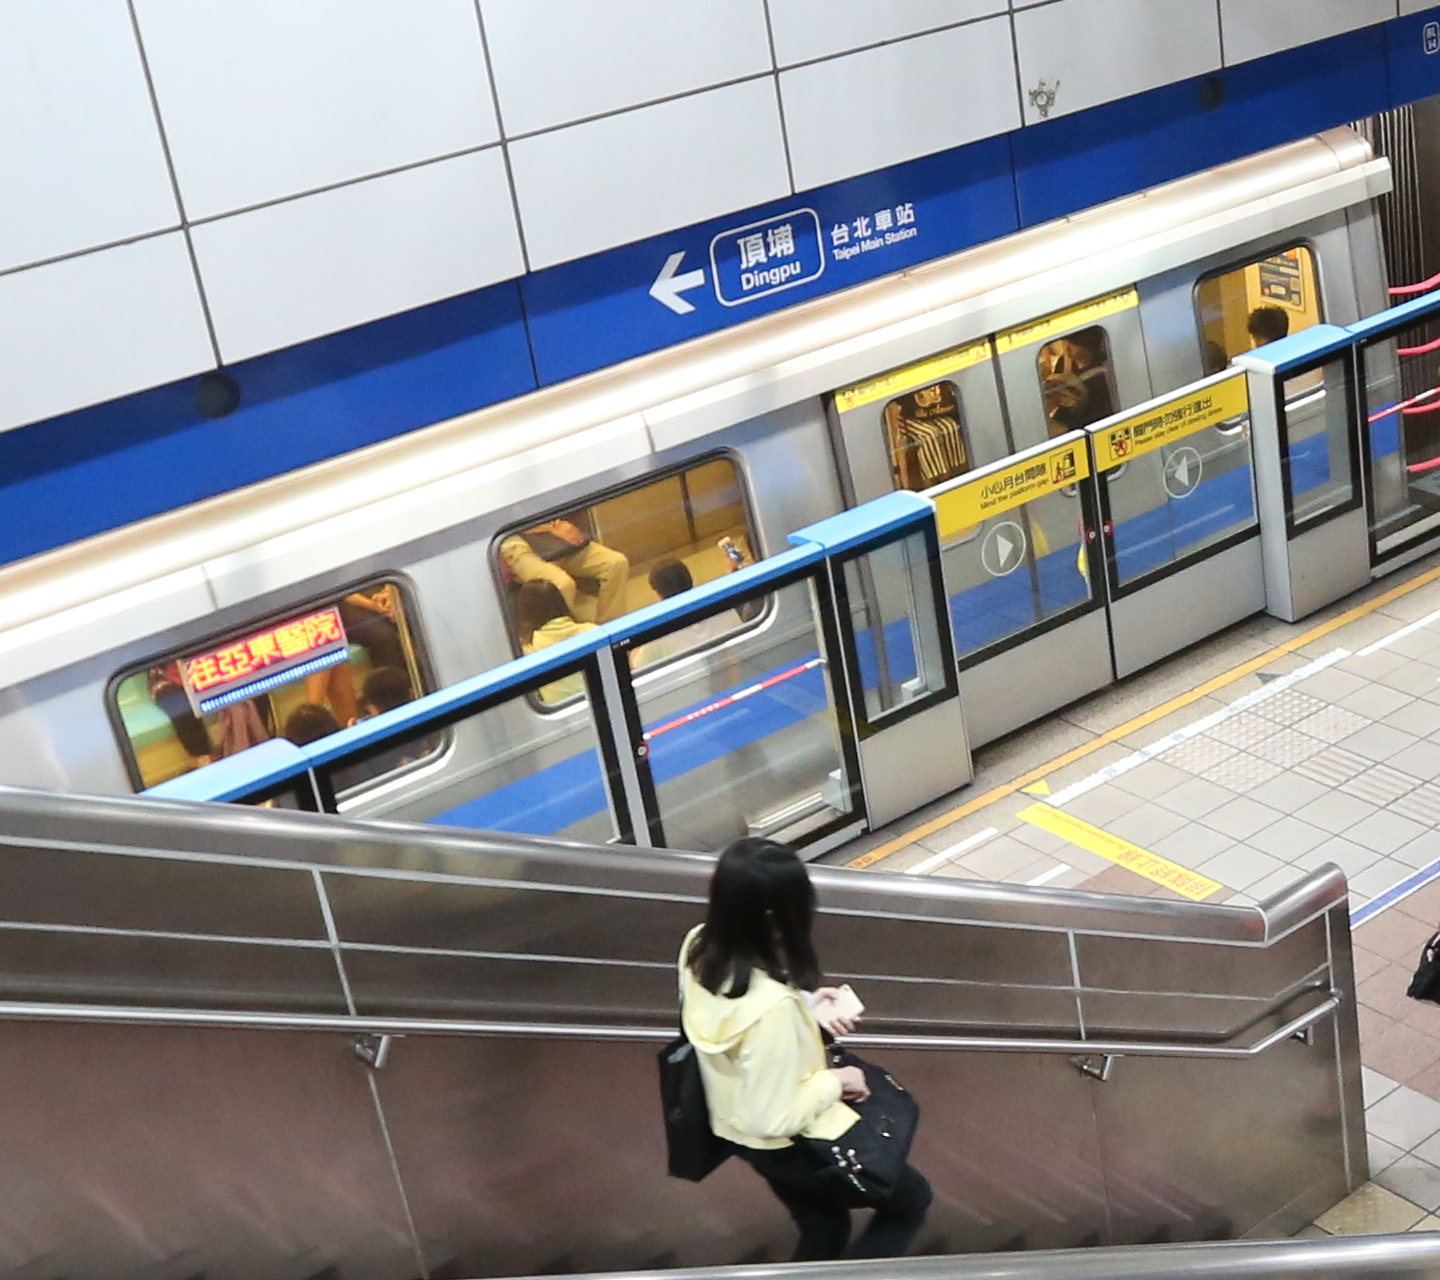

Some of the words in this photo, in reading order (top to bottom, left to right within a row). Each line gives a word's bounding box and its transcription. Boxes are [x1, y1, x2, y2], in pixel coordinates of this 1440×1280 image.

[736, 223, 796, 270] 頂埔
[830, 202, 916, 247] 台北車站
[832, 241, 861, 261] Taipei
[861, 234, 882, 253] Main
[883, 226, 917, 247] Station
[740, 260, 801, 291] Dingpu
[187, 611, 343, 691] 往亞東醫院
